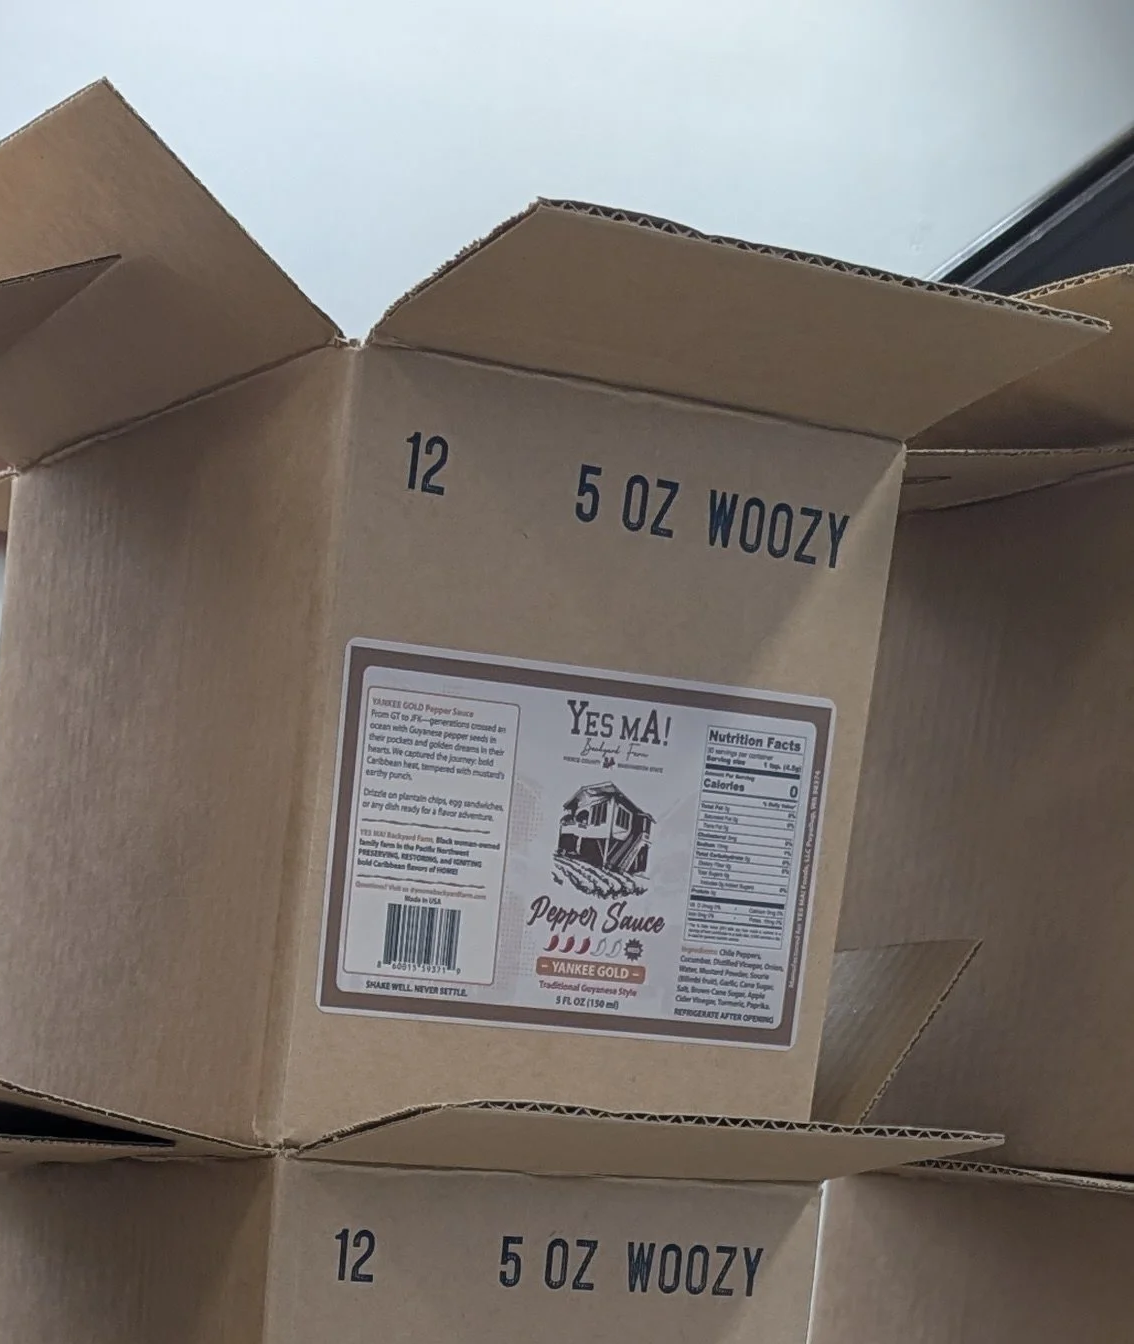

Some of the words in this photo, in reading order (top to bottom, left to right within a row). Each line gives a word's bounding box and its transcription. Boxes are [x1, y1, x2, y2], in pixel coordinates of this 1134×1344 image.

[406, 431, 449, 496] 12
[575, 464, 602, 523] 5
[622, 474, 680, 538] OZ
[709, 489, 850, 568] WOOZY
[567, 698, 614, 738] YES
[708, 729, 763, 747] Nutrition
[766, 736, 801, 752] Facts
[703, 777, 745, 792] Calories
[788, 785, 798, 798] 0
[526, 895, 598, 933] Pepper
[601, 898, 666, 934] Sauce
[551, 960, 595, 976] YANKEE
[596, 965, 629, 979] GOLD
[366, 979, 391, 990] SHAKE
[391, 982, 413, 992] WELL.
[414, 984, 439, 994] NEVER
[439, 986, 468, 997] SETTLE.
[335, 1228, 376, 1283] 12
[499, 1236, 523, 1287] 5
[544, 1238, 599, 1291] OZ
[627, 1241, 764, 1297] WOOZY
